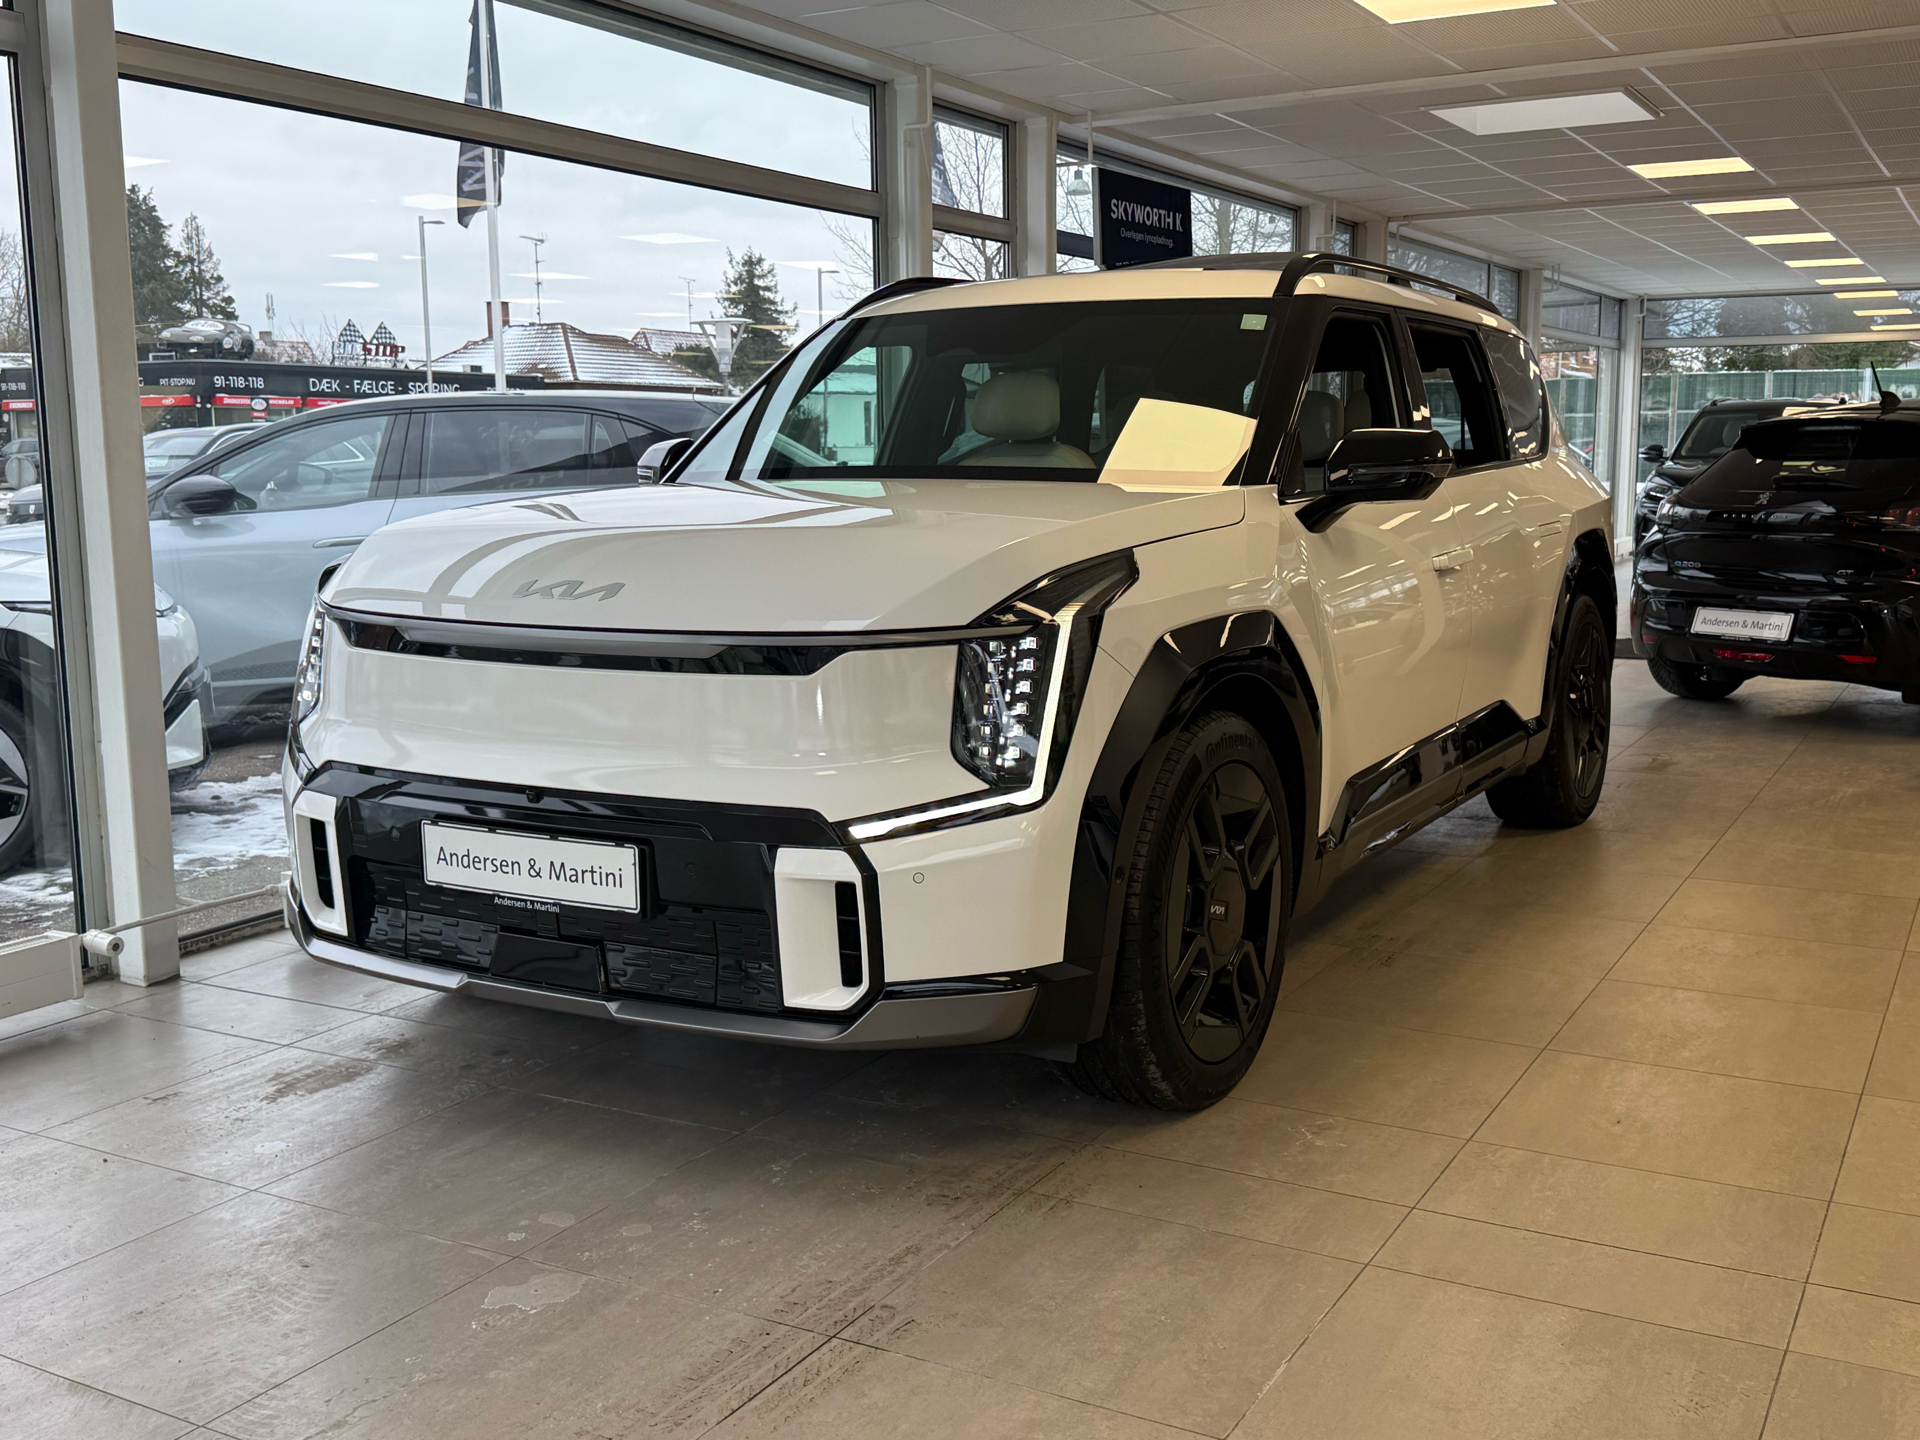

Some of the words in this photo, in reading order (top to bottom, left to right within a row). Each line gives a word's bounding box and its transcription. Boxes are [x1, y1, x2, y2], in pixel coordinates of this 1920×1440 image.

[1110, 198, 1173, 230] SKYWORTH
[1120, 227, 1144, 242] Overlegen
[213, 375, 265, 388] 91-118-118
[309, 378, 341, 393] DÆK
[353, 379, 396, 394] FÆLGE
[1700, 617, 1740, 628] Andersen
[1741, 620, 1748, 629] &
[1749, 620, 1784, 631] Martini
[1205, 732, 1256, 768] Continental
[436, 846, 522, 876] Andersen
[527, 858, 543, 879] &
[548, 861, 624, 889] Martini
[494, 896, 526, 908] Andersen
[526, 901, 533, 909] &
[534, 901, 560, 913] Martini
